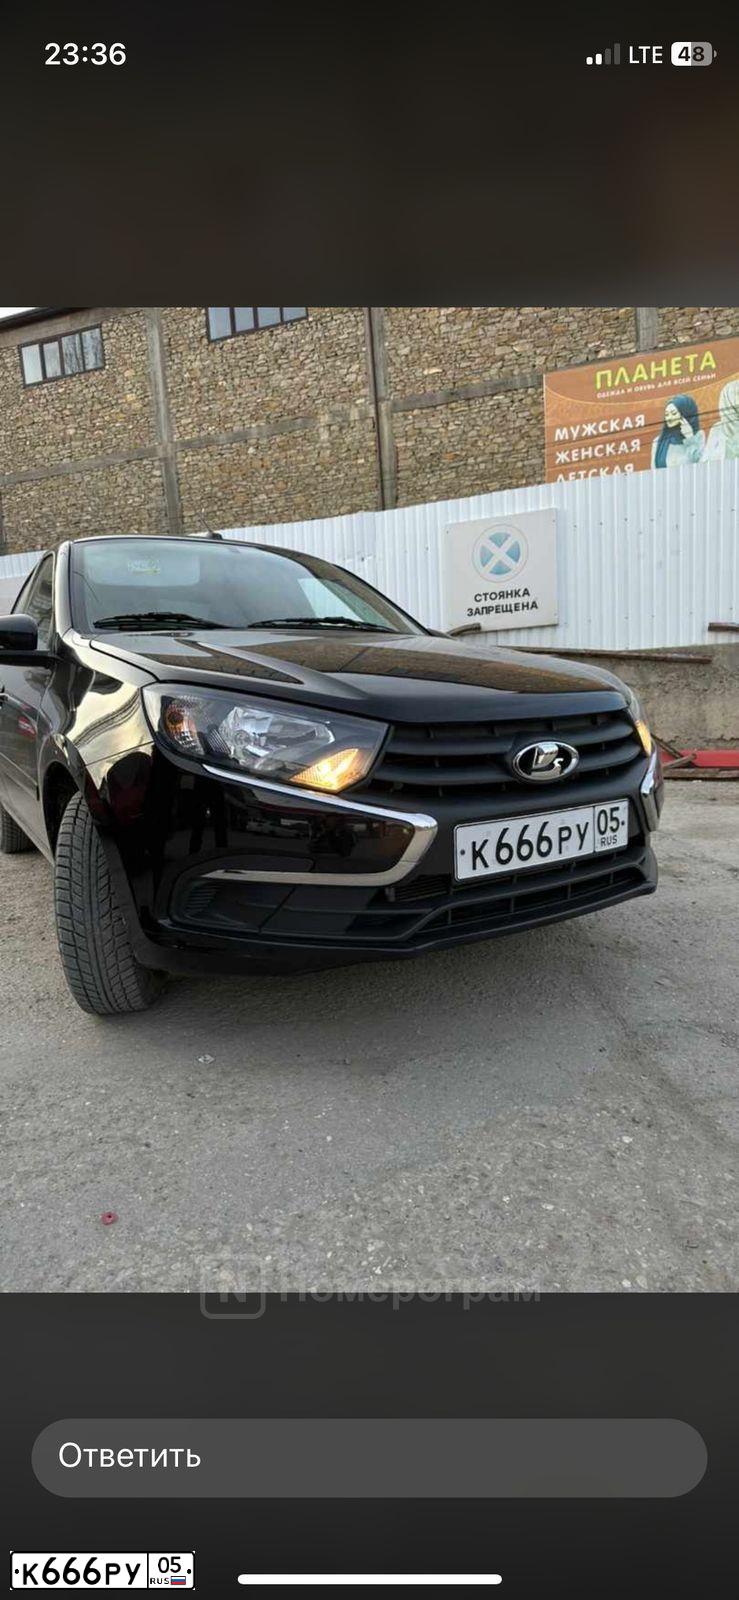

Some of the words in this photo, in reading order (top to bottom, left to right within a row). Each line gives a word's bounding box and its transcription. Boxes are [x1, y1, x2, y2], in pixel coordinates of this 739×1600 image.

[596, 350, 716, 390] ПЛАНЕТА
[597, 389, 626, 399] ОДЕЖДА
[634, 384, 655, 392] ОБУВЬ
[657, 380, 671, 388] ДЛЯ
[673, 376, 691, 385] ВСЕЙ
[693, 372, 716, 382] СЕМЬИ
[554, 414, 646, 442] МУЖСКАЯ
[555, 438, 641, 465] ЖЕНСКАЯ
[467, 600, 539, 617] ЗАПРЕЩЕНА
[474, 587, 531, 603] СТОЯНКА
[471, 821, 590, 871] К666РУ
[597, 806, 620, 836] 05
[600, 834, 618, 847] RUS
